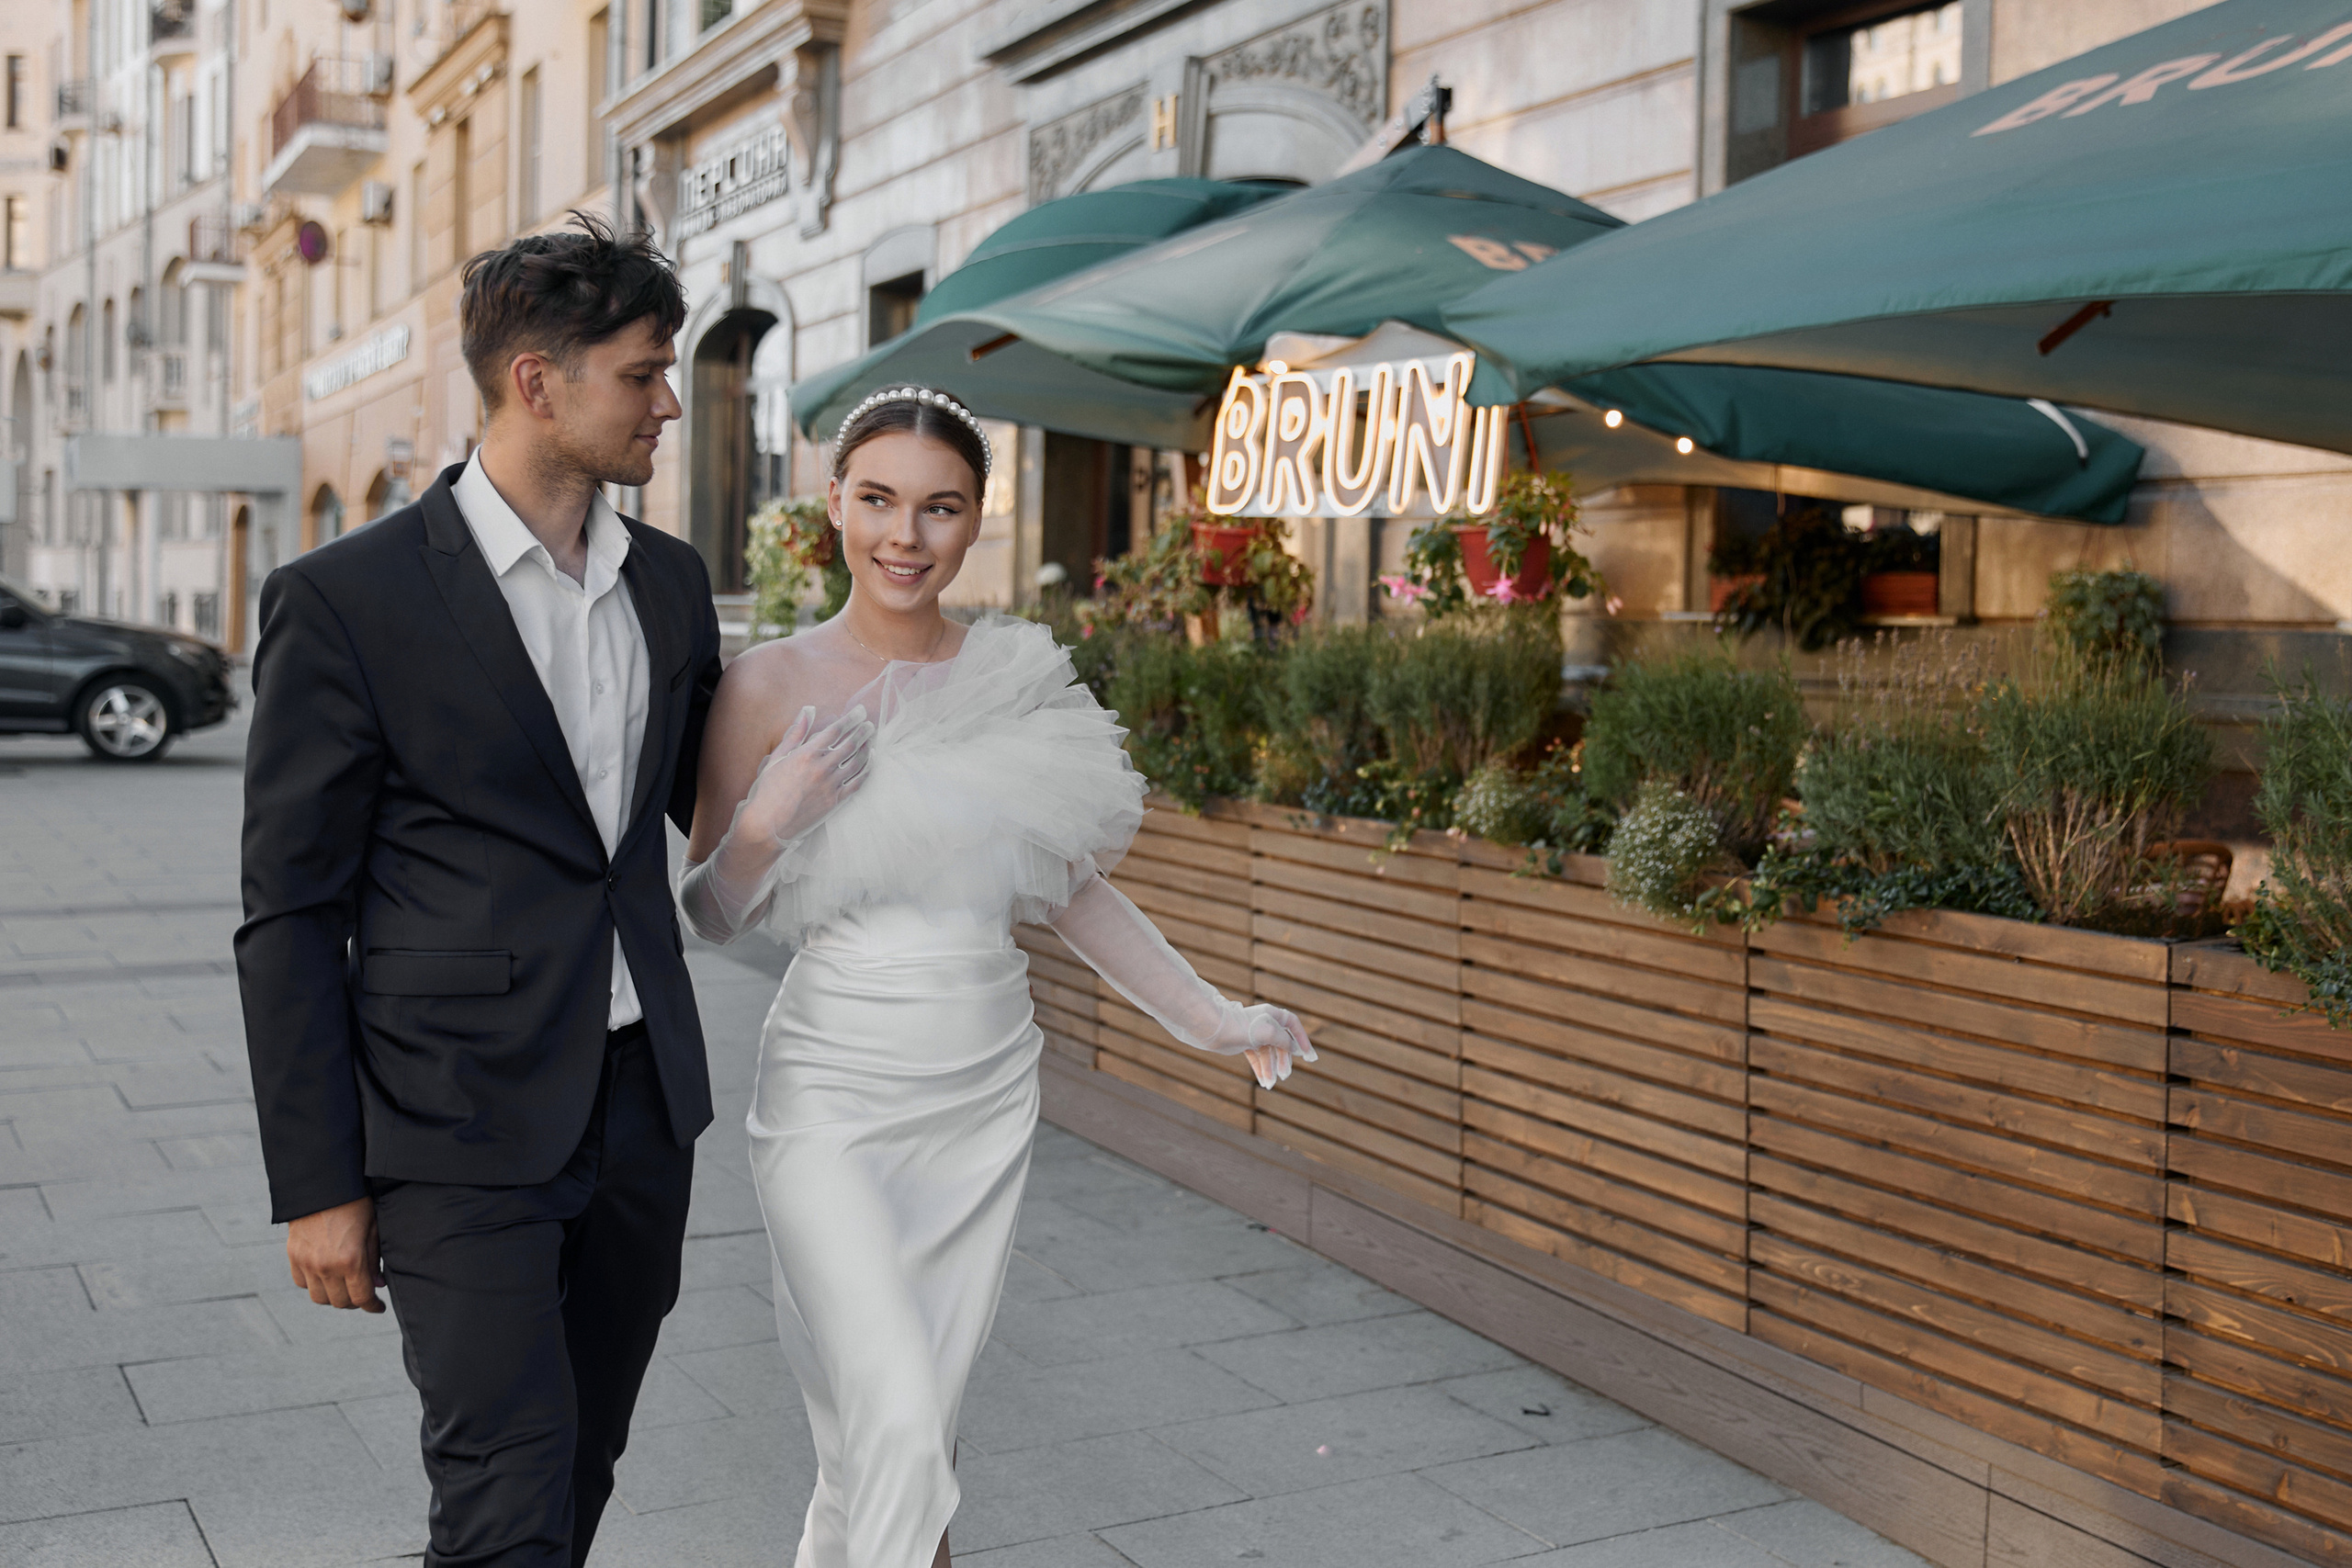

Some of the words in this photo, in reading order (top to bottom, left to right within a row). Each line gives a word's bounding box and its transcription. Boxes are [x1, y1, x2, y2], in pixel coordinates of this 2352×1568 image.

[1968, 20, 2352, 138] BRU
[678, 123, 787, 219] ПЕРСОНА
[1205, 347, 1510, 515] BRUNI
